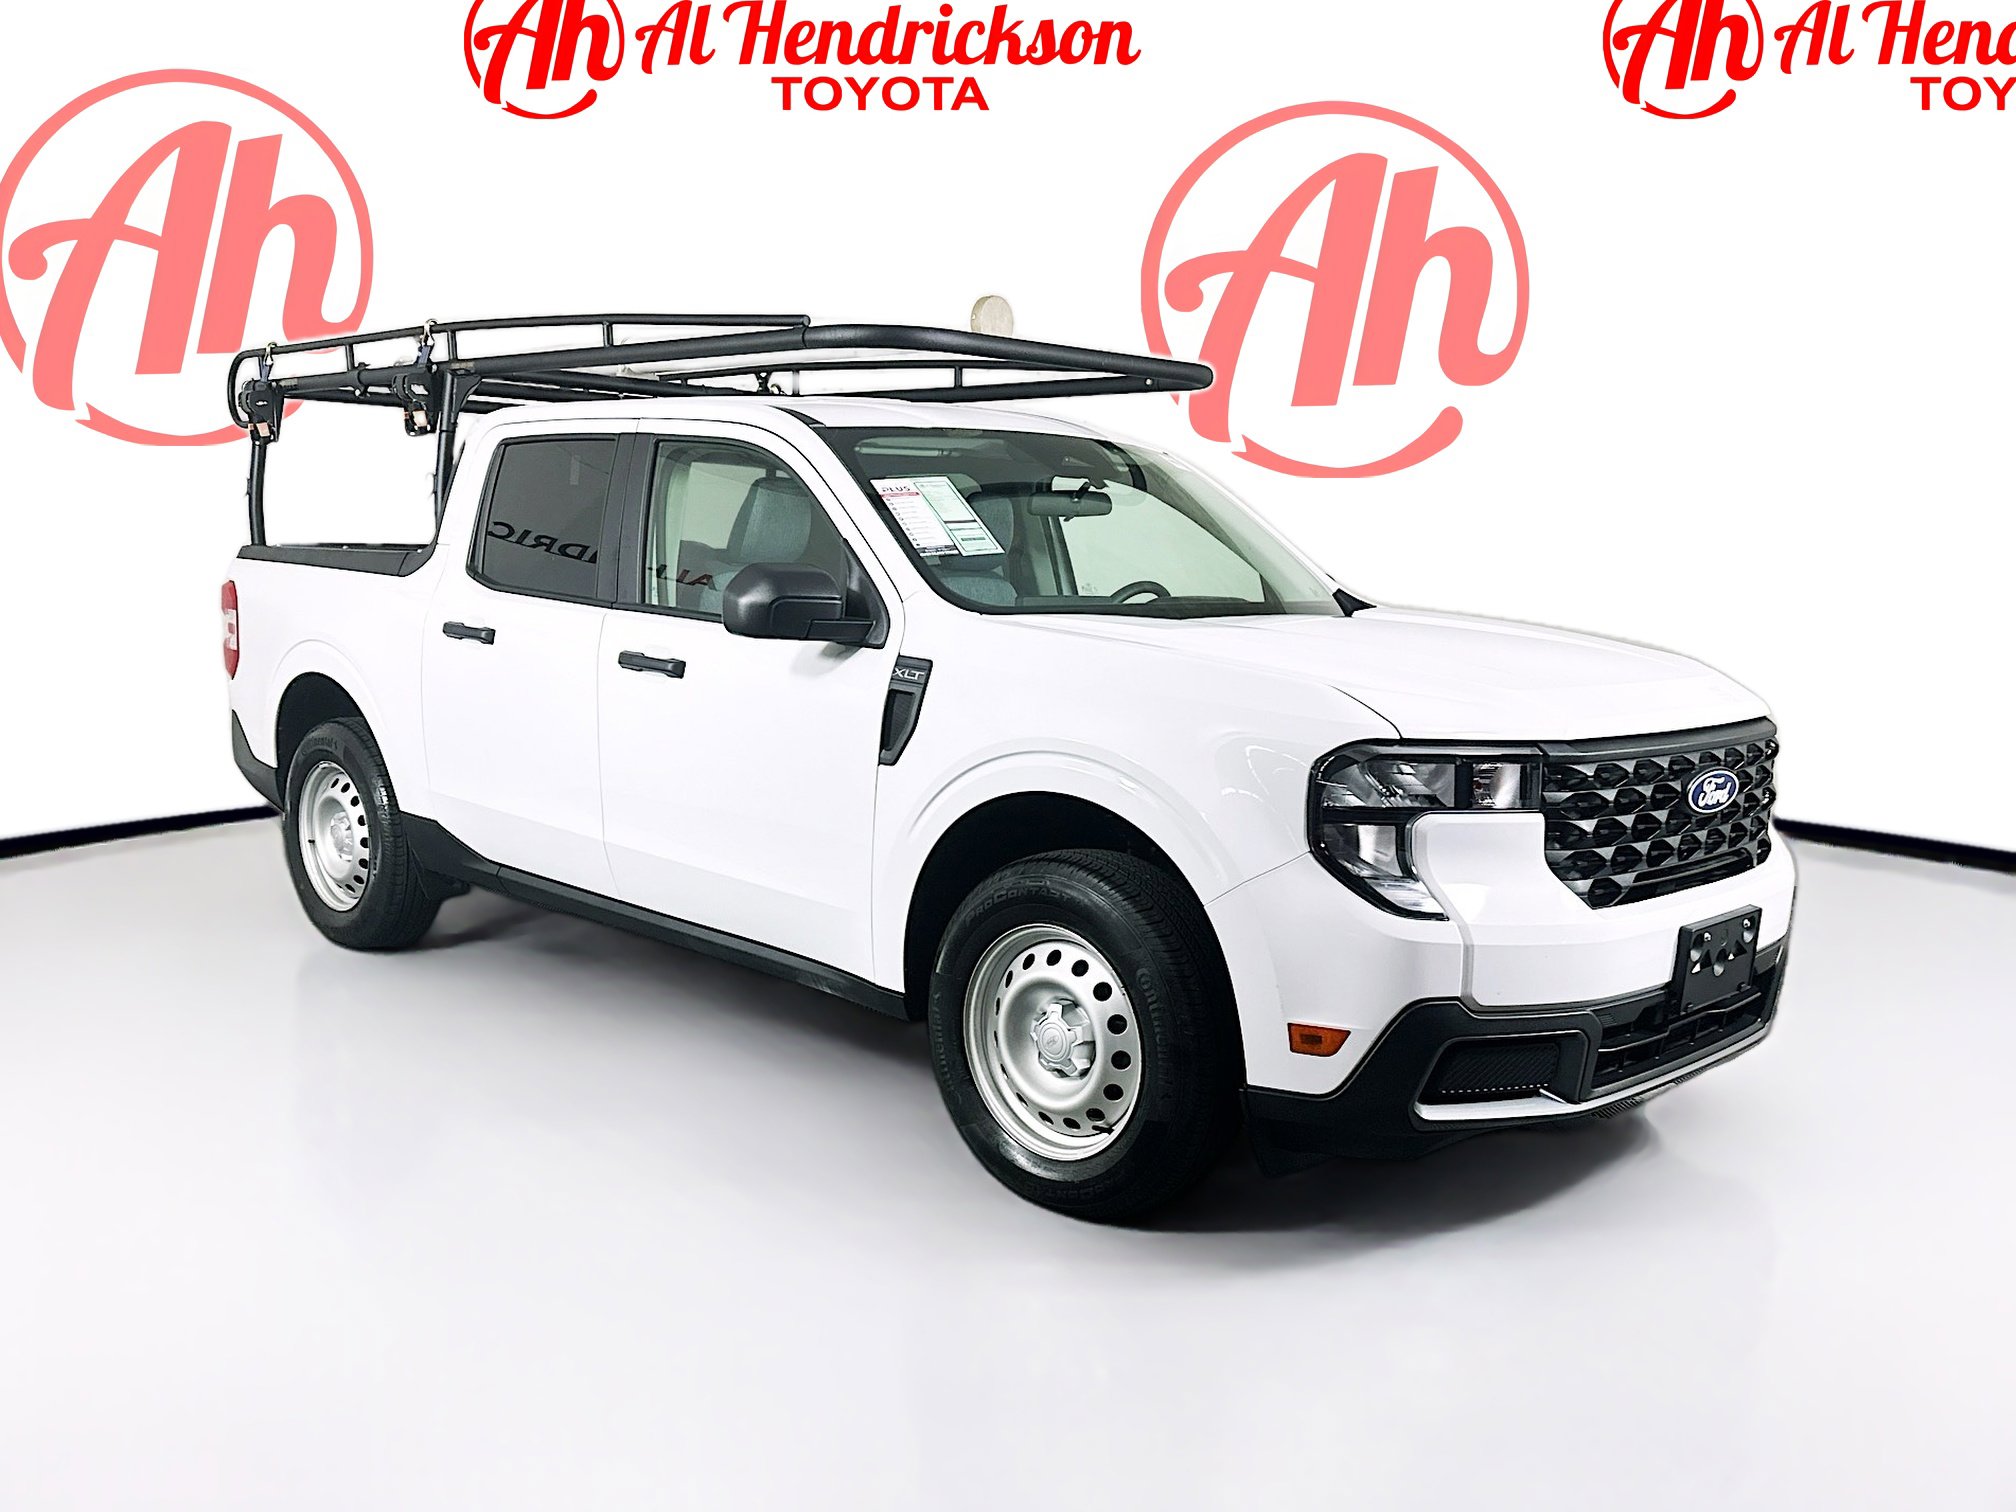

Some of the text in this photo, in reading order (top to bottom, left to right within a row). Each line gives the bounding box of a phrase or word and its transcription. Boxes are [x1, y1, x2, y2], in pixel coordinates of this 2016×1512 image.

[473, 0, 613, 104] Ah
[635, 0, 1141, 74] Al Hendrickson
[1613, 0, 1752, 104] Ah
[1774, 0, 1854, 74] Al
[771, 76, 988, 111] TOYOTA
[1910, 76, 2016, 111] TOY
[8, 121, 342, 410] Ah
[1164, 153, 1499, 442] Ah
[893, 667, 925, 680] XLT
[1698, 776, 1731, 807] Ford
